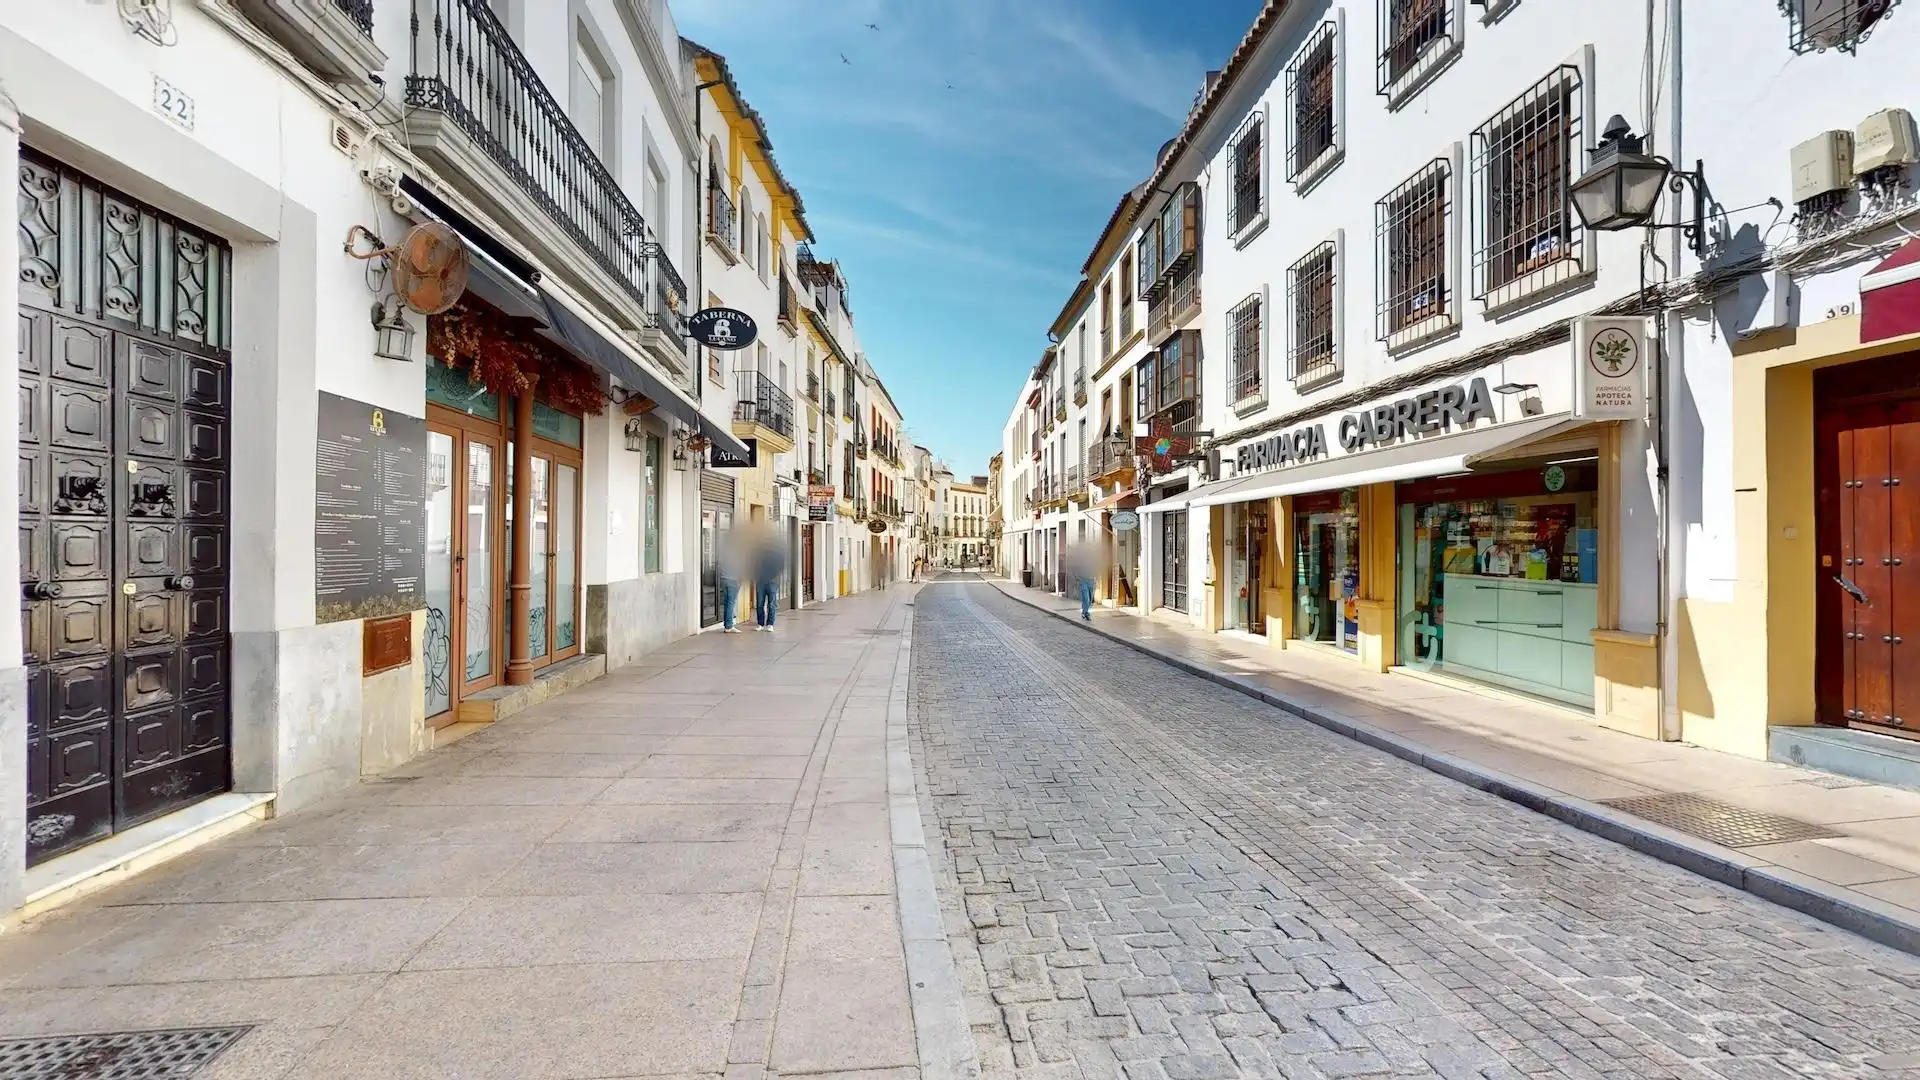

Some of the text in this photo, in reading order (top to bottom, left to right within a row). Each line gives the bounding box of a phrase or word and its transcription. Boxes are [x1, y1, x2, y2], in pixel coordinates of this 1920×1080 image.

[161, 89, 187, 120] 22
[692, 311, 751, 328] TABERNA
[714, 319, 731, 338] 6
[1237, 377, 1498, 472] FARMACIA CABRERA
